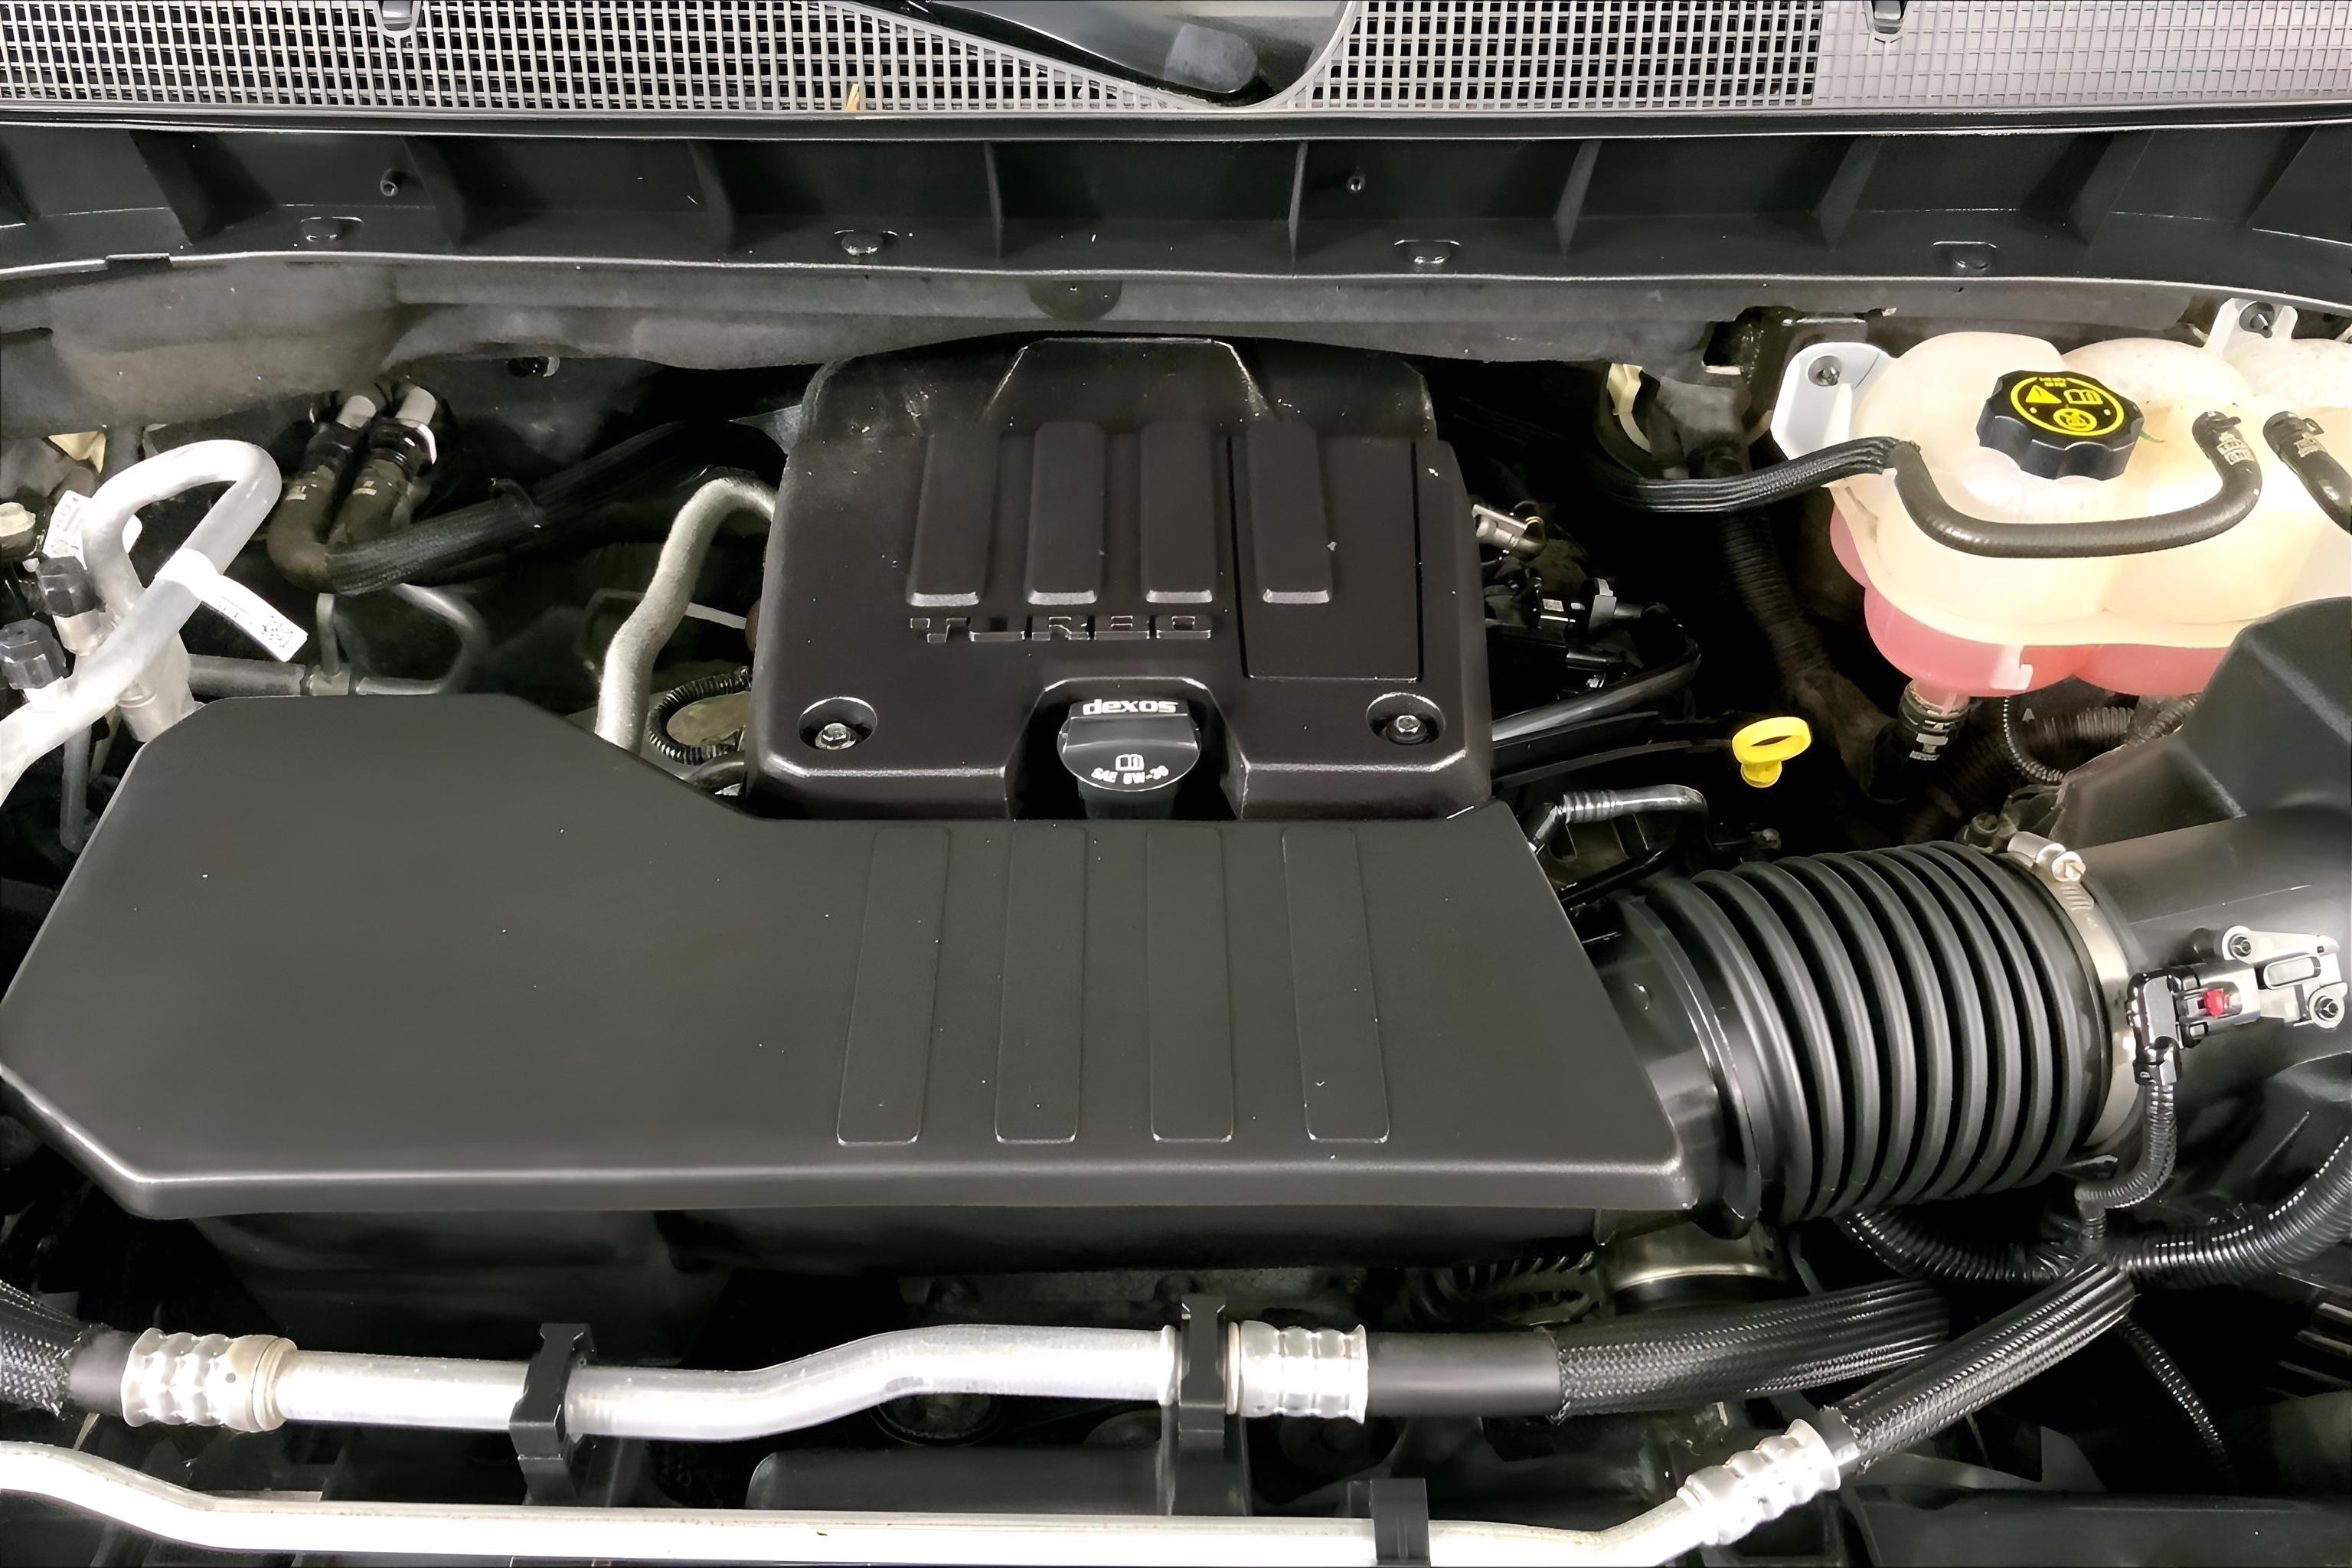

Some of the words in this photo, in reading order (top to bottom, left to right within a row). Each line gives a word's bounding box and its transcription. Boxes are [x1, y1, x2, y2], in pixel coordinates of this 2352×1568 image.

[910, 615, 1212, 643] TURBO
[1083, 698, 1179, 716] dexos
[1091, 767, 1118, 783] SAE
